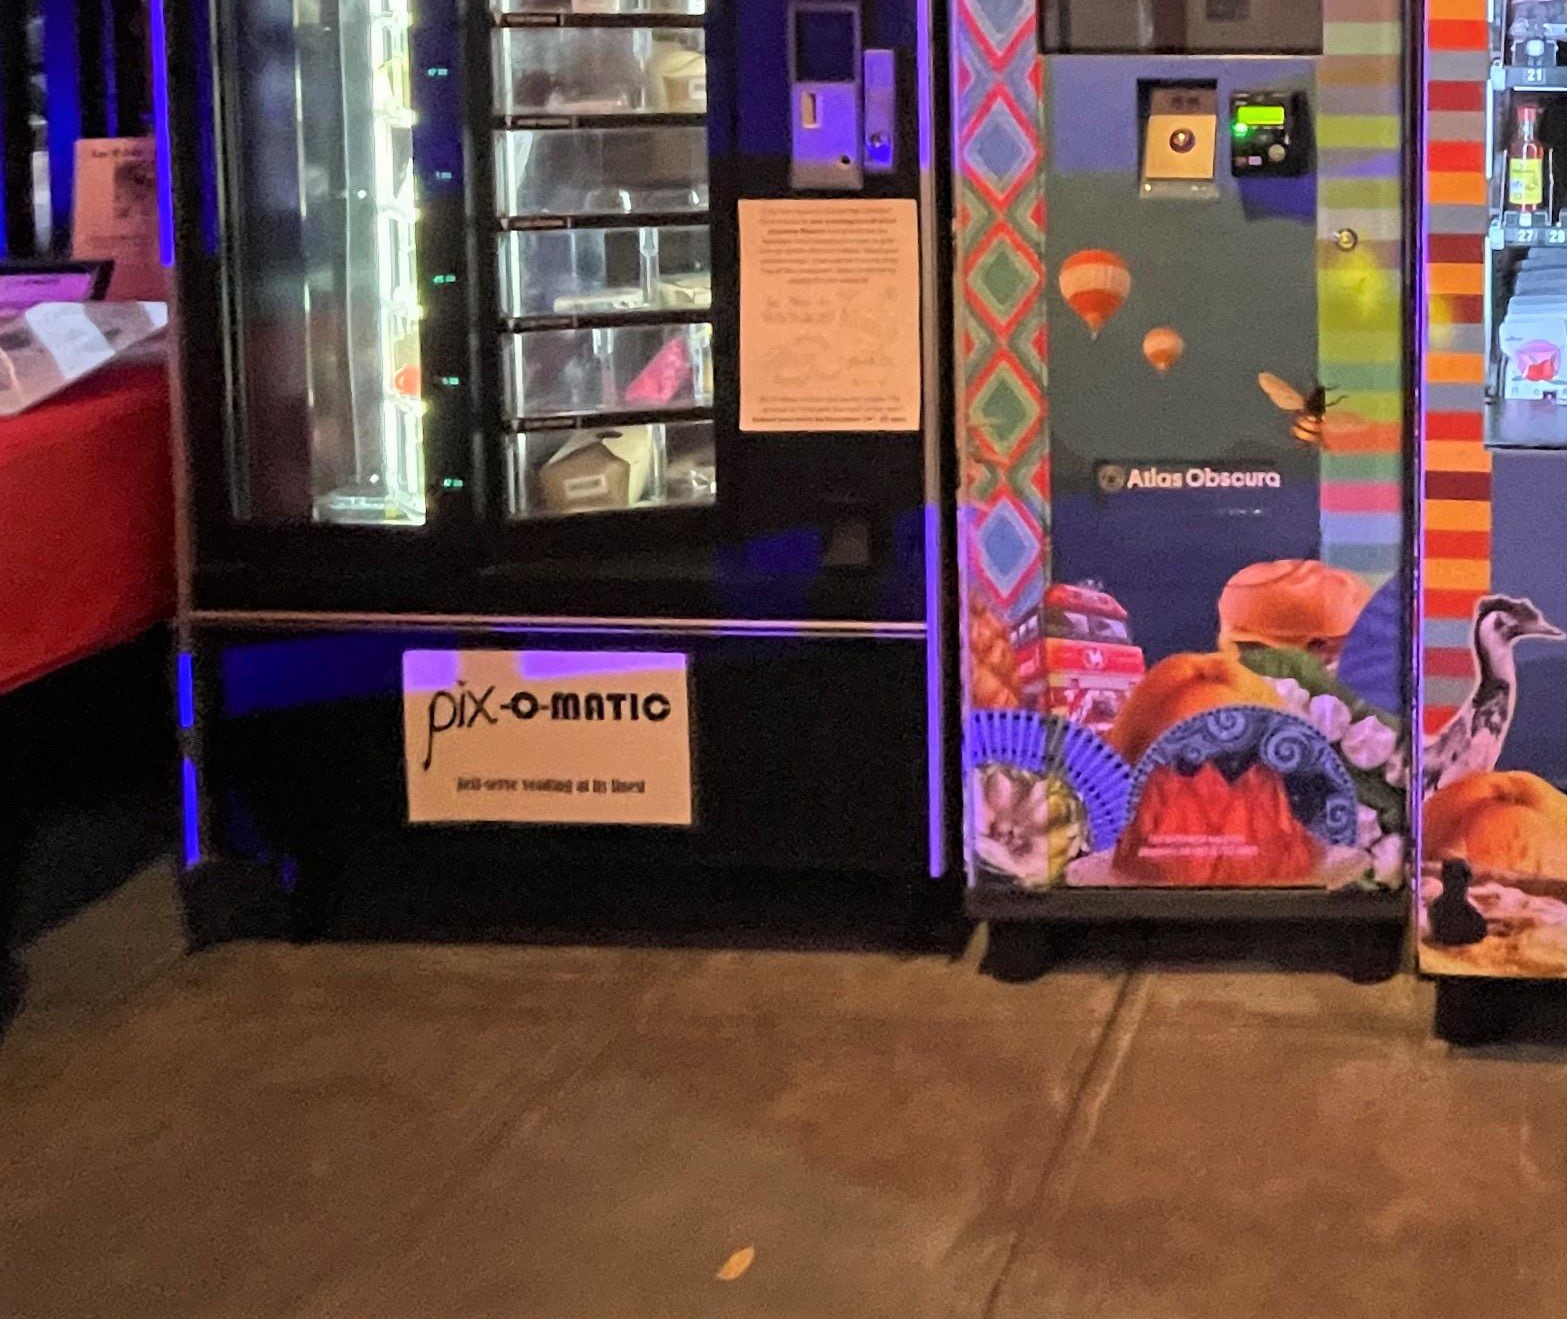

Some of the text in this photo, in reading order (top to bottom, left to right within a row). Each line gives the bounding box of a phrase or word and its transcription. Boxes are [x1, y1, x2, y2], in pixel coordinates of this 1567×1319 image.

[1526, 68, 1543, 81] 21
[1517, 231, 1533, 243] 27
[1127, 467, 1281, 489] Atlas Obscura
